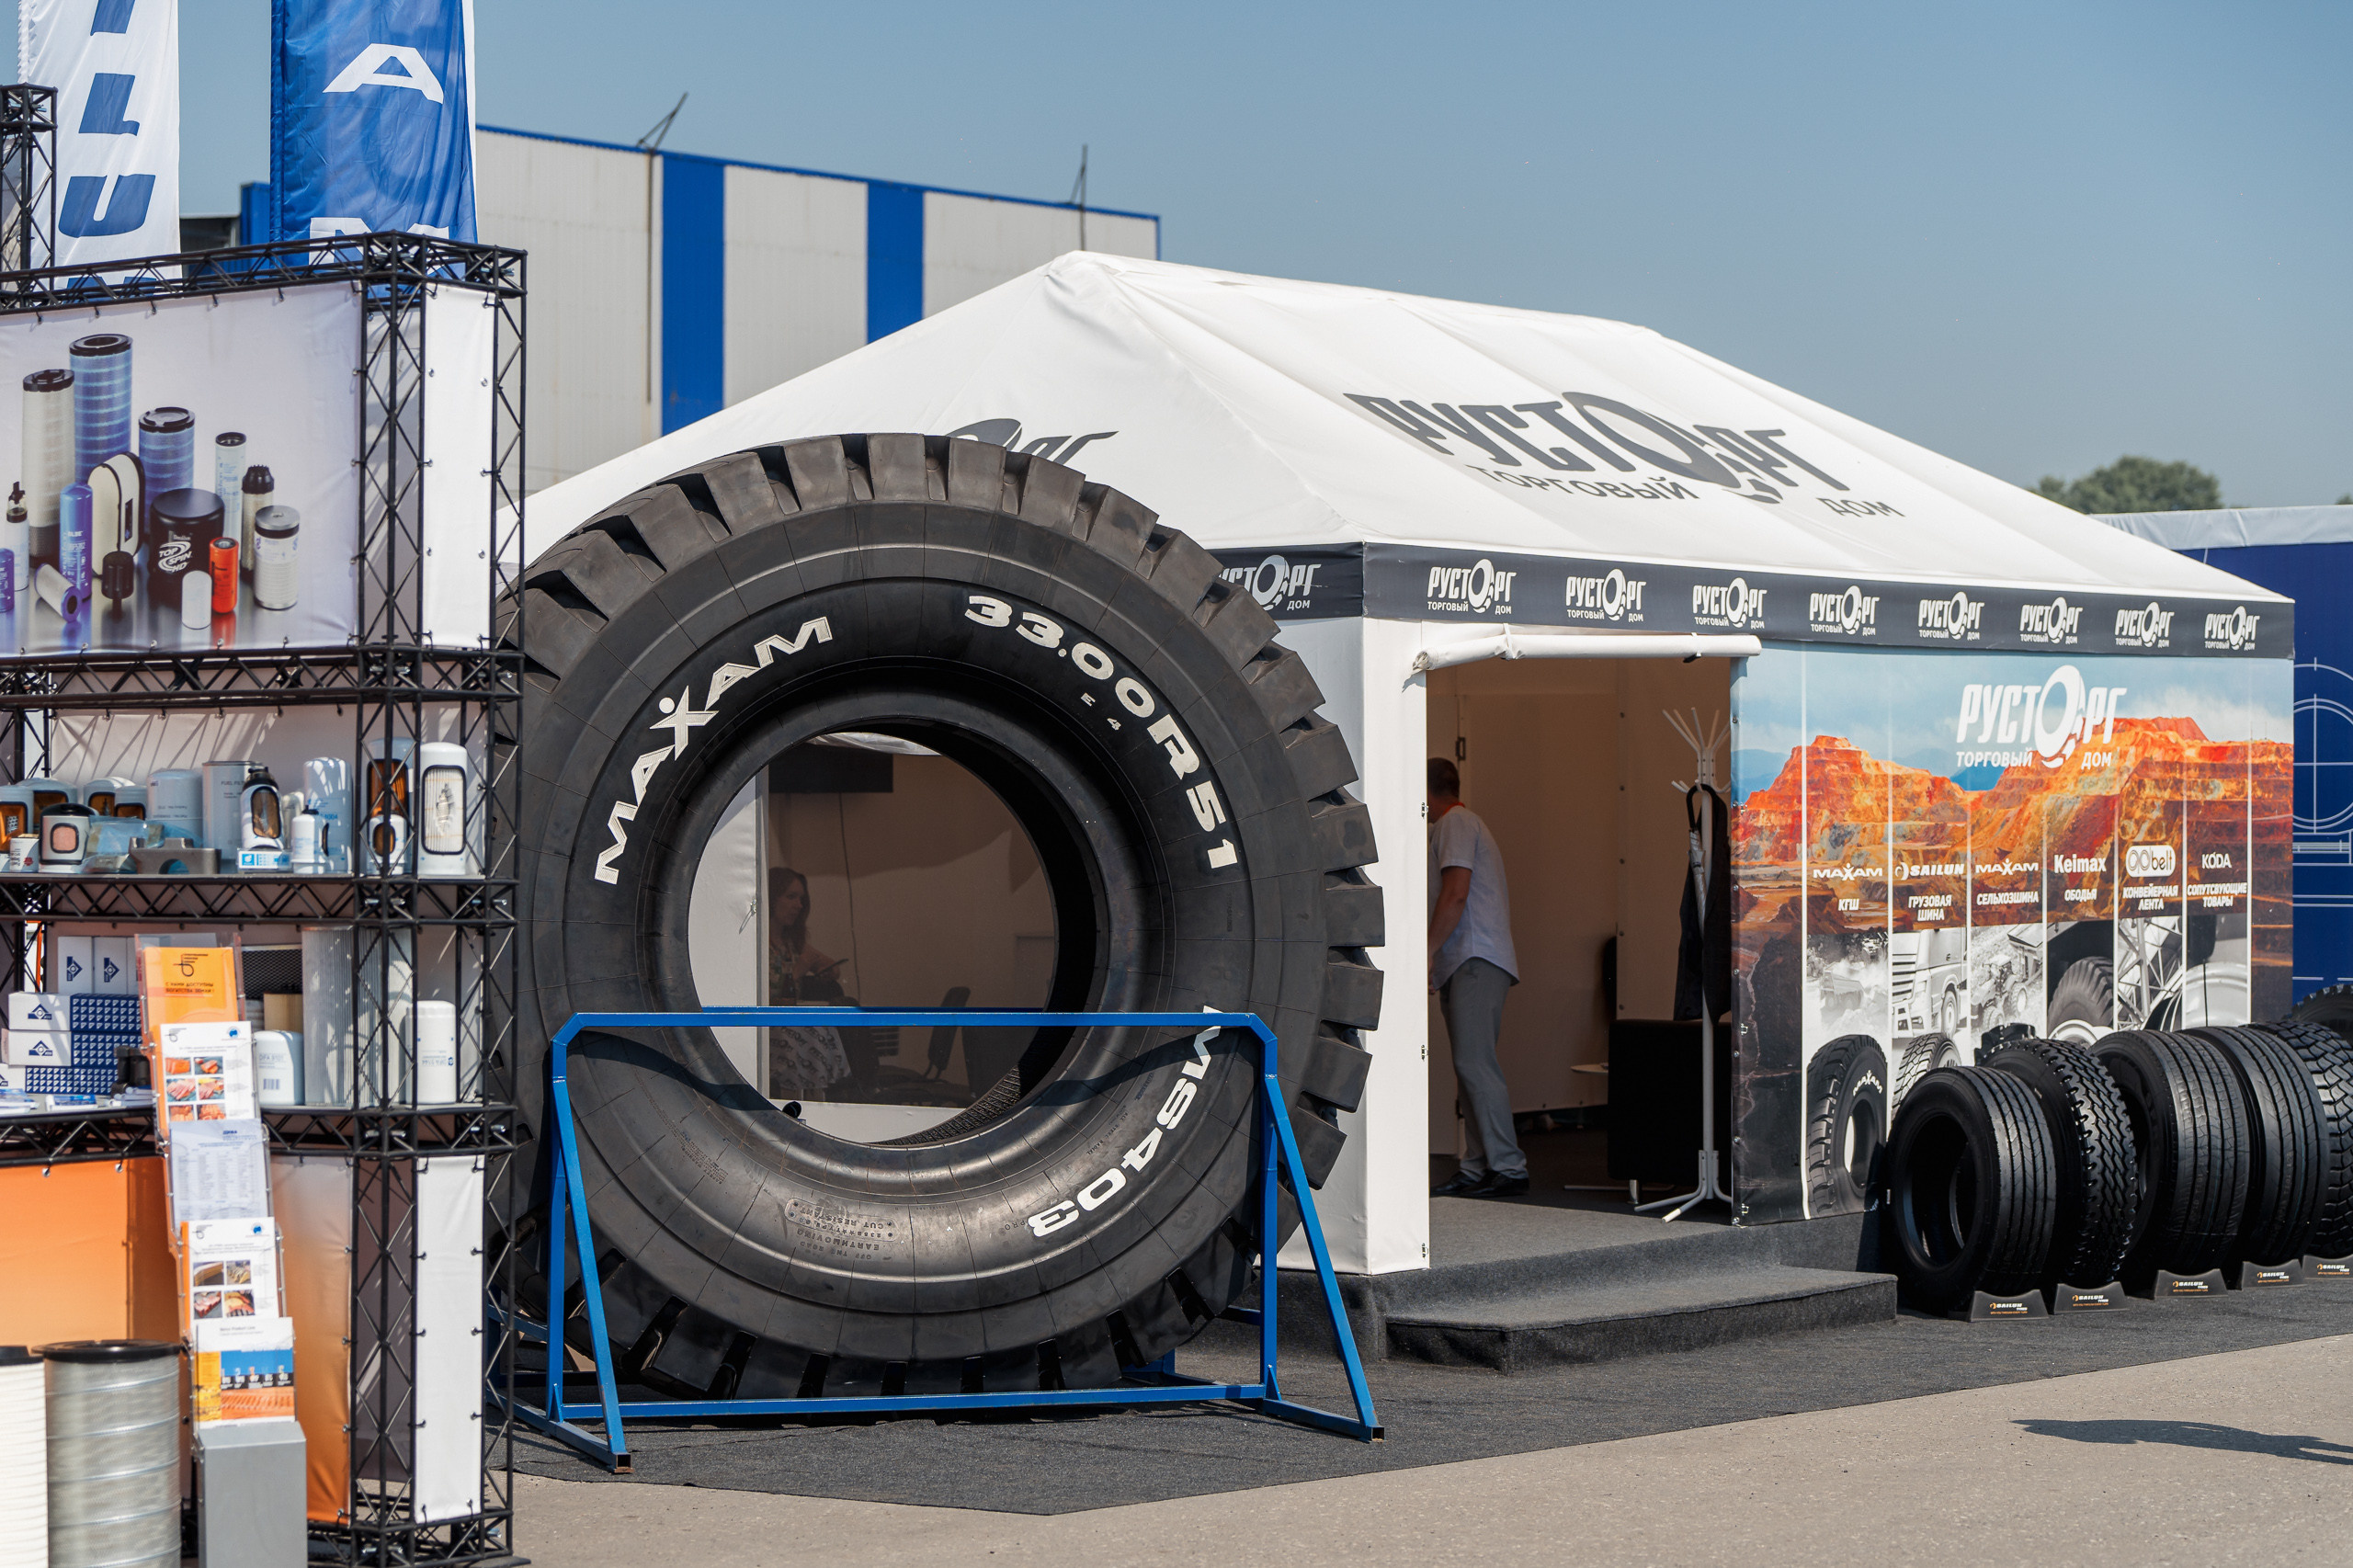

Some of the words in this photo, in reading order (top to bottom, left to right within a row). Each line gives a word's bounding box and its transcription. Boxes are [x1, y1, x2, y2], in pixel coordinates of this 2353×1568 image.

[1343, 392, 1849, 504] РУСТОРГ
[1465, 463, 1699, 500] ТОРГОВЫЙ
[1816, 496, 1906, 518] ДОМ
[158, 549, 178, 558] TOP
[171, 562, 188, 573] HD
[1427, 559, 1517, 613] РУСТОРГ
[1565, 569, 1646, 621] РУСТОРГ
[1692, 577, 1768, 628] РУСТОРГ
[1287, 600, 1311, 611] ДОМ
[1427, 601, 1469, 612] ТОРГОВЫЙ
[1495, 605, 1512, 615] ДОМ
[1809, 585, 1880, 635] РУСТОРГ
[1566, 608, 1605, 619] ТОРГОВЫЙ
[1628, 612, 1643, 622] ДОМ
[1917, 591, 1985, 640] РУСТОРГ
[2019, 597, 2083, 643] РУСТОРГ
[1694, 616, 1729, 627] ТОРГОВЫЙ
[1750, 619, 1765, 630] ДОМ
[1810, 623, 1843, 633] ТОРГОВЫЙ
[1862, 626, 1876, 636] ДОМ
[2115, 601, 2175, 648] РУСТОРГ
[2204, 606, 2260, 651] РУСТОРГ
[1918, 629, 1949, 639] ТОРГОВЫЙ
[1967, 631, 1980, 641] ДОМ
[2020, 632, 2049, 642] ТОРГОВЫЙ
[2065, 635, 2078, 644] ДОМ
[2116, 637, 2143, 647] ТОРГОВЫЙ
[2157, 640, 2170, 648] ДОМ
[1956, 665, 2128, 768] РУСТОРГ
[965, 595, 1240, 869] 33.00R51
[595, 616, 833, 885] MAXAM
[1956, 747, 2033, 767] ТОРГОВЫЙ
[2081, 752, 2112, 769] ДОМ
[1909, 863, 1965, 876] SAILUN
[1975, 858, 2039, 876] MAXAM
[2053, 854, 2107, 874] Keimax
[1813, 863, 1882, 881] MAXAM
[1976, 891, 2039, 905] СЕЛЬХОЗШИНА
[2064, 888, 2097, 902] ОБОДЬЯ
[2122, 883, 2178, 899] КОНВЕЙЕРНАЯ
[1838, 898, 1859, 911] КГШ
[1908, 893, 1952, 908] ГРУЗОВАЯ
[2138, 898, 2165, 911] ЛЕНТА
[2202, 894, 2234, 908] ТОВАРЫ
[1917, 908, 1945, 921] ШИНА
[1853, 1070, 1882, 1096] MAXAM
[1029, 1006, 1223, 1237] MS403
[799, 1207, 858, 1226] RESISTANT
[863, 1221, 884, 1230] CUT
[1004, 1220, 1026, 1231] PRO
[796, 1228, 880, 1252] EARTHMOVING
[800, 1241, 824, 1253] ROAD
[854, 1252, 872, 1261] OFF
